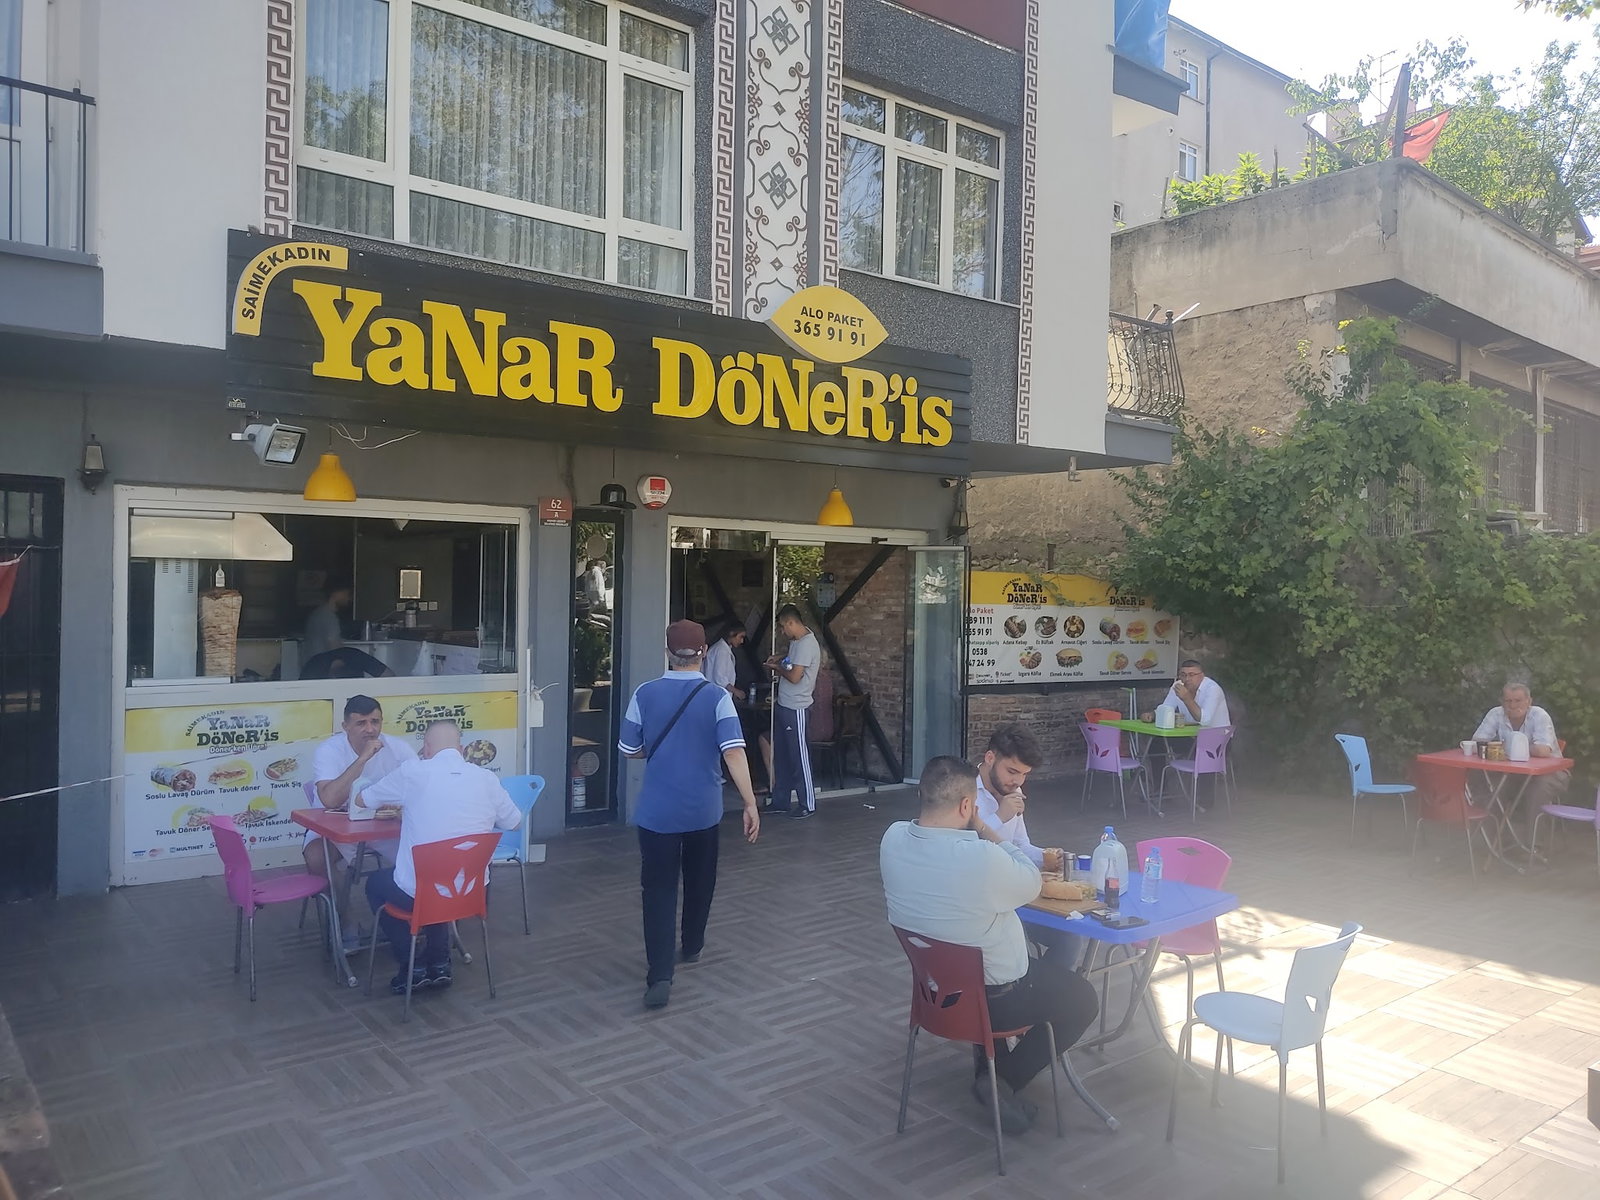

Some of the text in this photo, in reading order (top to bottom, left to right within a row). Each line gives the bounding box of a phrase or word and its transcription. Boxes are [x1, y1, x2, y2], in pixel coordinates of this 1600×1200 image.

[241, 247, 331, 320] SAİMEKADIN
[800, 305, 864, 328] ALO PAKET
[793, 319, 866, 347] 365 91 91
[292, 278, 624, 413] YaNaR
[550, 499, 562, 509] 62
[972, 648, 988, 656] 0538
[976, 659, 985, 667] 24
[240, 784, 261, 792] döner
[168, 791, 189, 799] Lavaş
[190, 788, 215, 797] Dürüm
[178, 826, 200, 834] Döner
[175, 844, 204, 852] MULTINET
